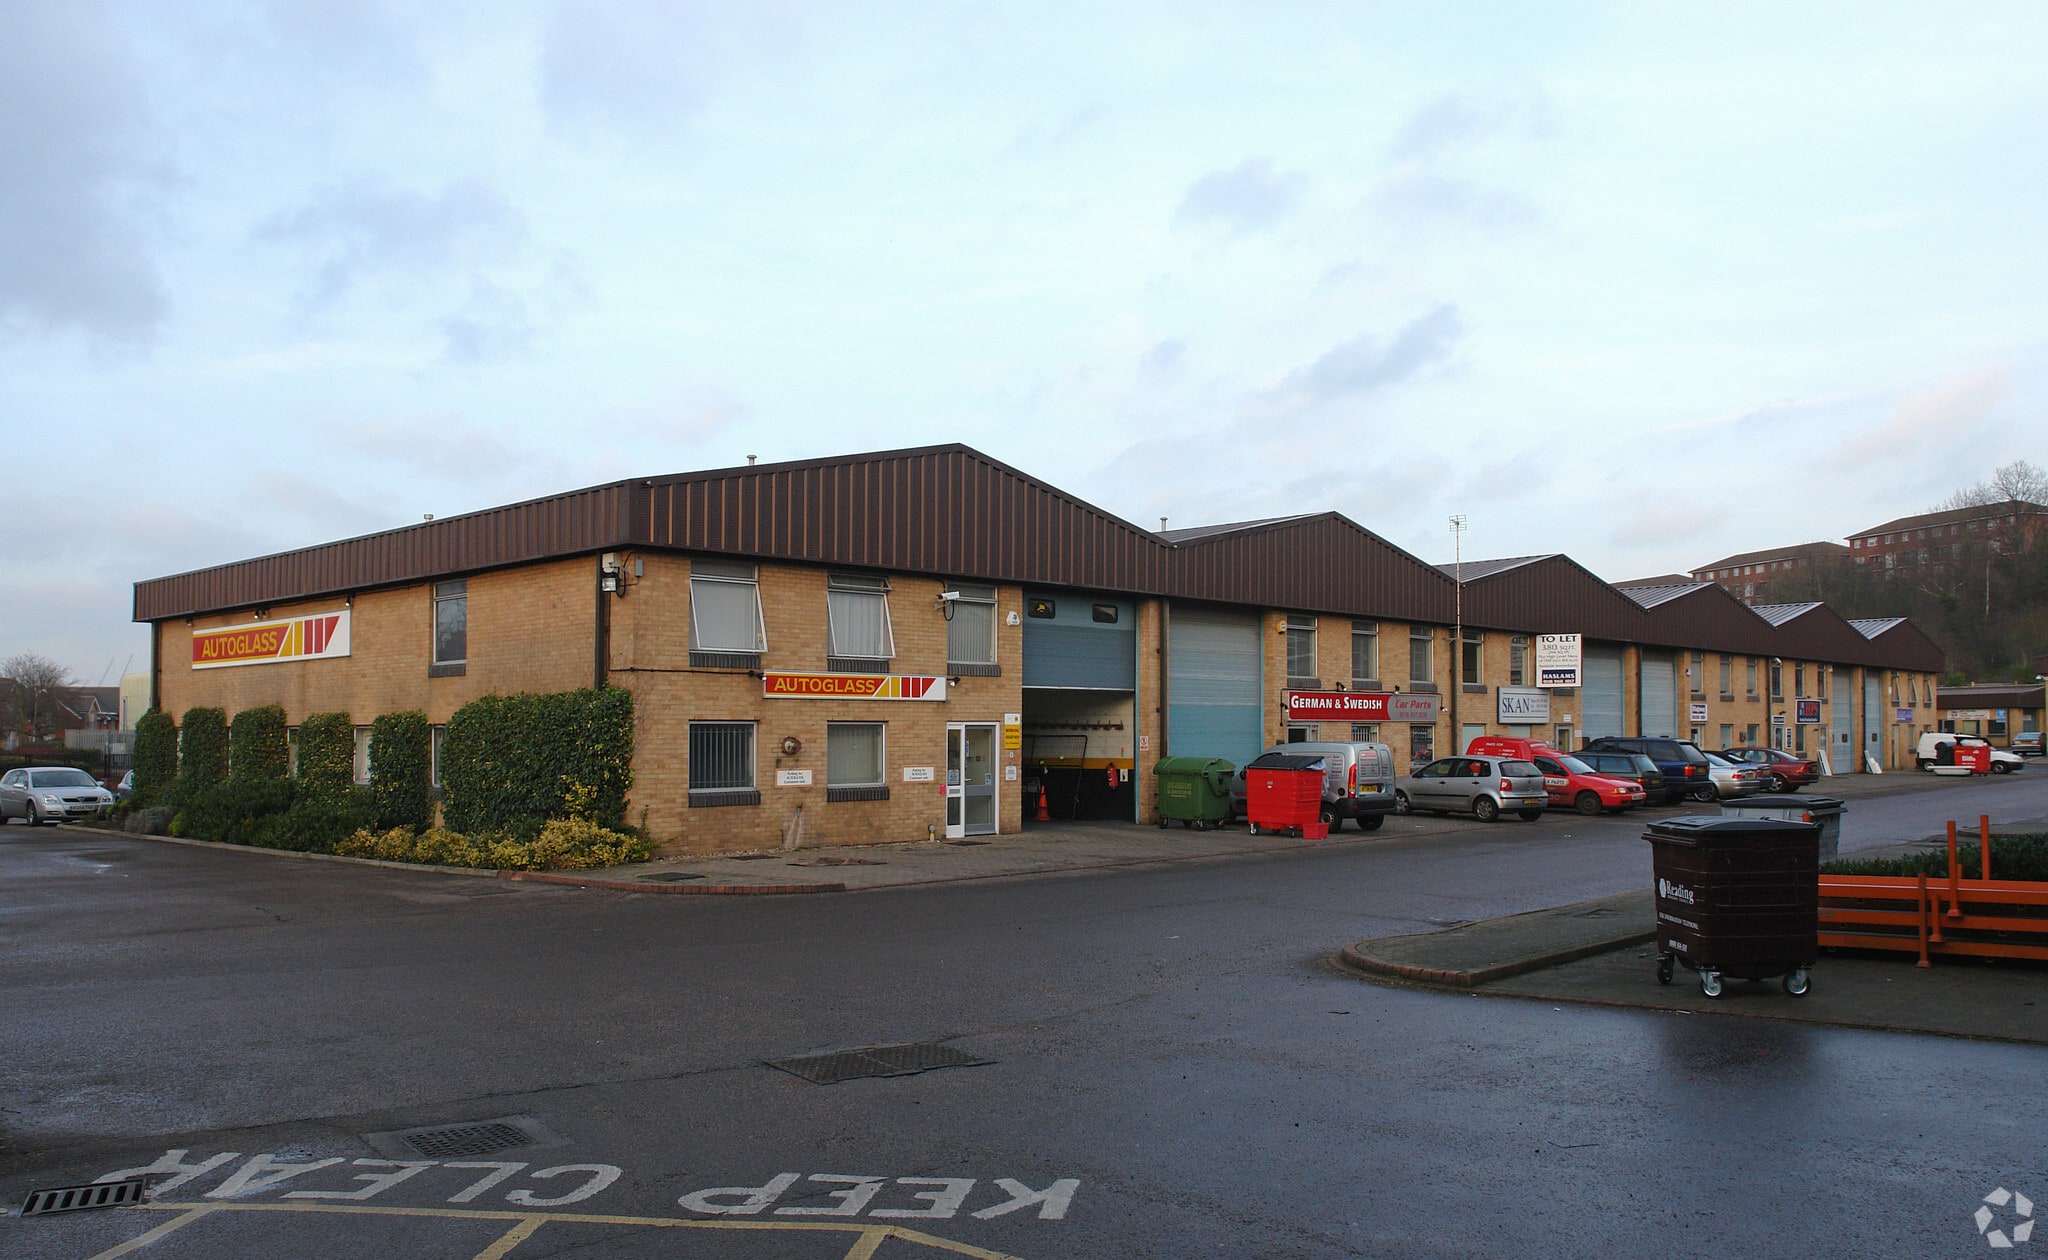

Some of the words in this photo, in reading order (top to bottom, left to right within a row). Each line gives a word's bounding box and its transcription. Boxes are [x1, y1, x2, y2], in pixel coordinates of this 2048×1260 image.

[202, 631, 277, 657] AUTOGLASS
[774, 678, 875, 693] AUTOGLASS
[1291, 695, 1332, 708] GERMAN
[1335, 699, 1341, 708] &
[1344, 697, 1382, 709] SWEDISH
[1396, 699, 1409, 708] Car
[1410, 699, 1432, 708] Parts
[1502, 698, 1530, 713] SKAN
[1666, 879, 1694, 905] Reading
[91, 1149, 622, 1206] CLEAR
[677, 1173, 1081, 1219] KEEP
